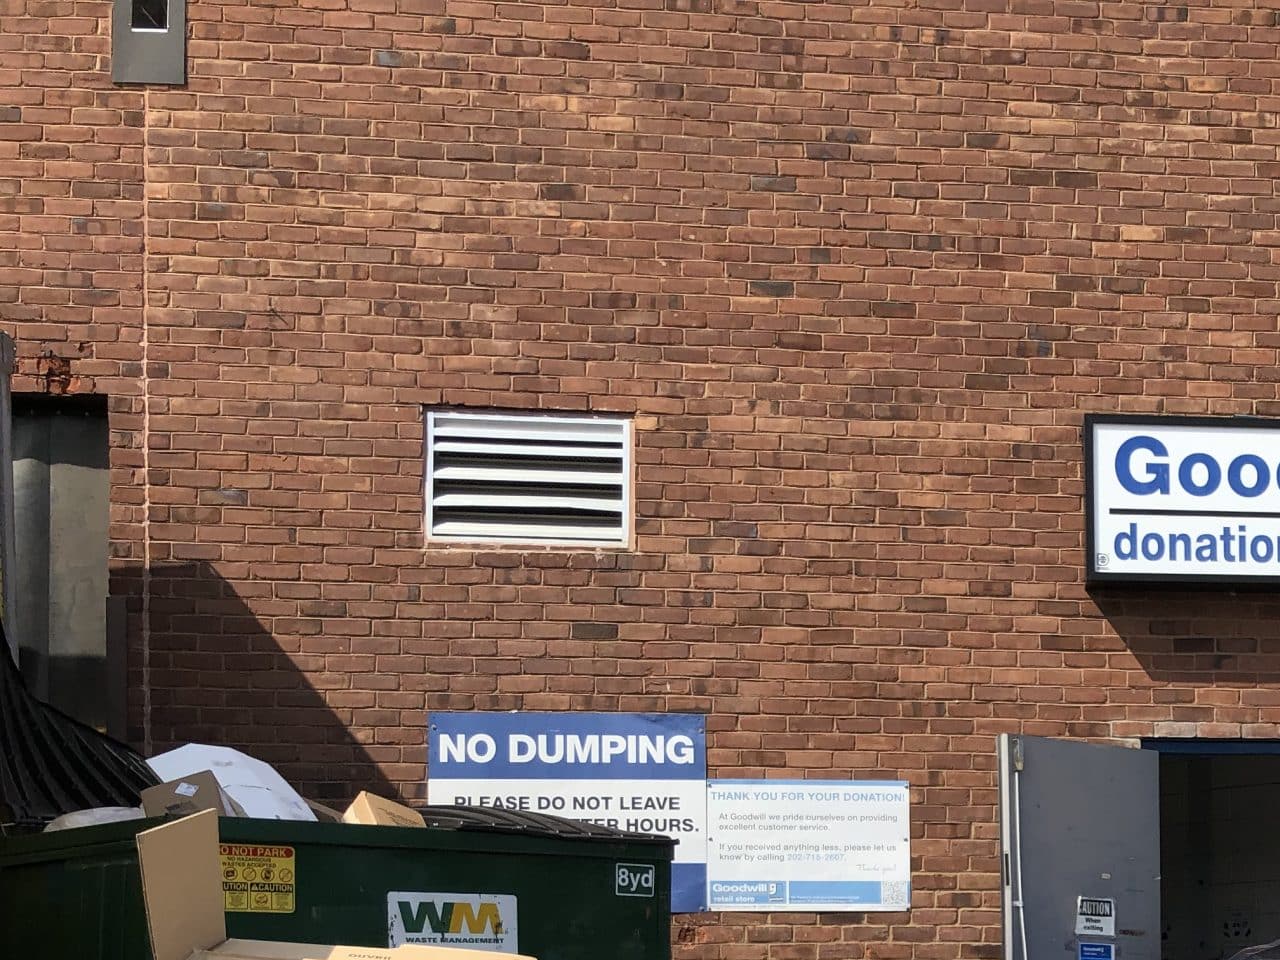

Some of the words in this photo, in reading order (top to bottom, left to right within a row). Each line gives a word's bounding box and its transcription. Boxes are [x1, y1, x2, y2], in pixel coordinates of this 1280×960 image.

[439, 734, 497, 763] NO
[509, 735, 695, 765] DUMPING
[711, 791, 750, 801] THANK
[753, 792, 778, 801] YOU
[781, 792, 804, 801] FOR
[808, 792, 840, 802] YOUR
[844, 793, 905, 802] DONATION!
[455, 796, 530, 810] PLEASE
[537, 796, 566, 810] DO
[573, 796, 613, 810] NOT
[620, 797, 681, 810] LEAVE
[719, 813, 728, 821] At
[730, 813, 766, 821] Goodwill
[783, 813, 804, 823] pride
[806, 813, 845, 822] ourselves
[860, 814, 898, 824] providing
[626, 819, 699, 832] HOURS.
[759, 823, 797, 831] customer
[220, 846, 229, 855] O
[232, 847, 255, 856] NOT
[257, 848, 286, 857] PARK
[719, 843, 726, 851] If
[727, 844, 742, 853] you
[745, 843, 781, 851] received
[783, 844, 819, 853] anything
[843, 844, 871, 853] please
[744, 854, 755, 863] by
[757, 854, 785, 863] calling
[618, 868, 653, 891] 8yd
[259, 883, 293, 892] CAUTION
[713, 883, 767, 893] Goodwill
[714, 895, 734, 903] retail
[735, 895, 755, 903] store
[398, 902, 504, 934] WM
[440, 936, 504, 944] MANAGEMENT
